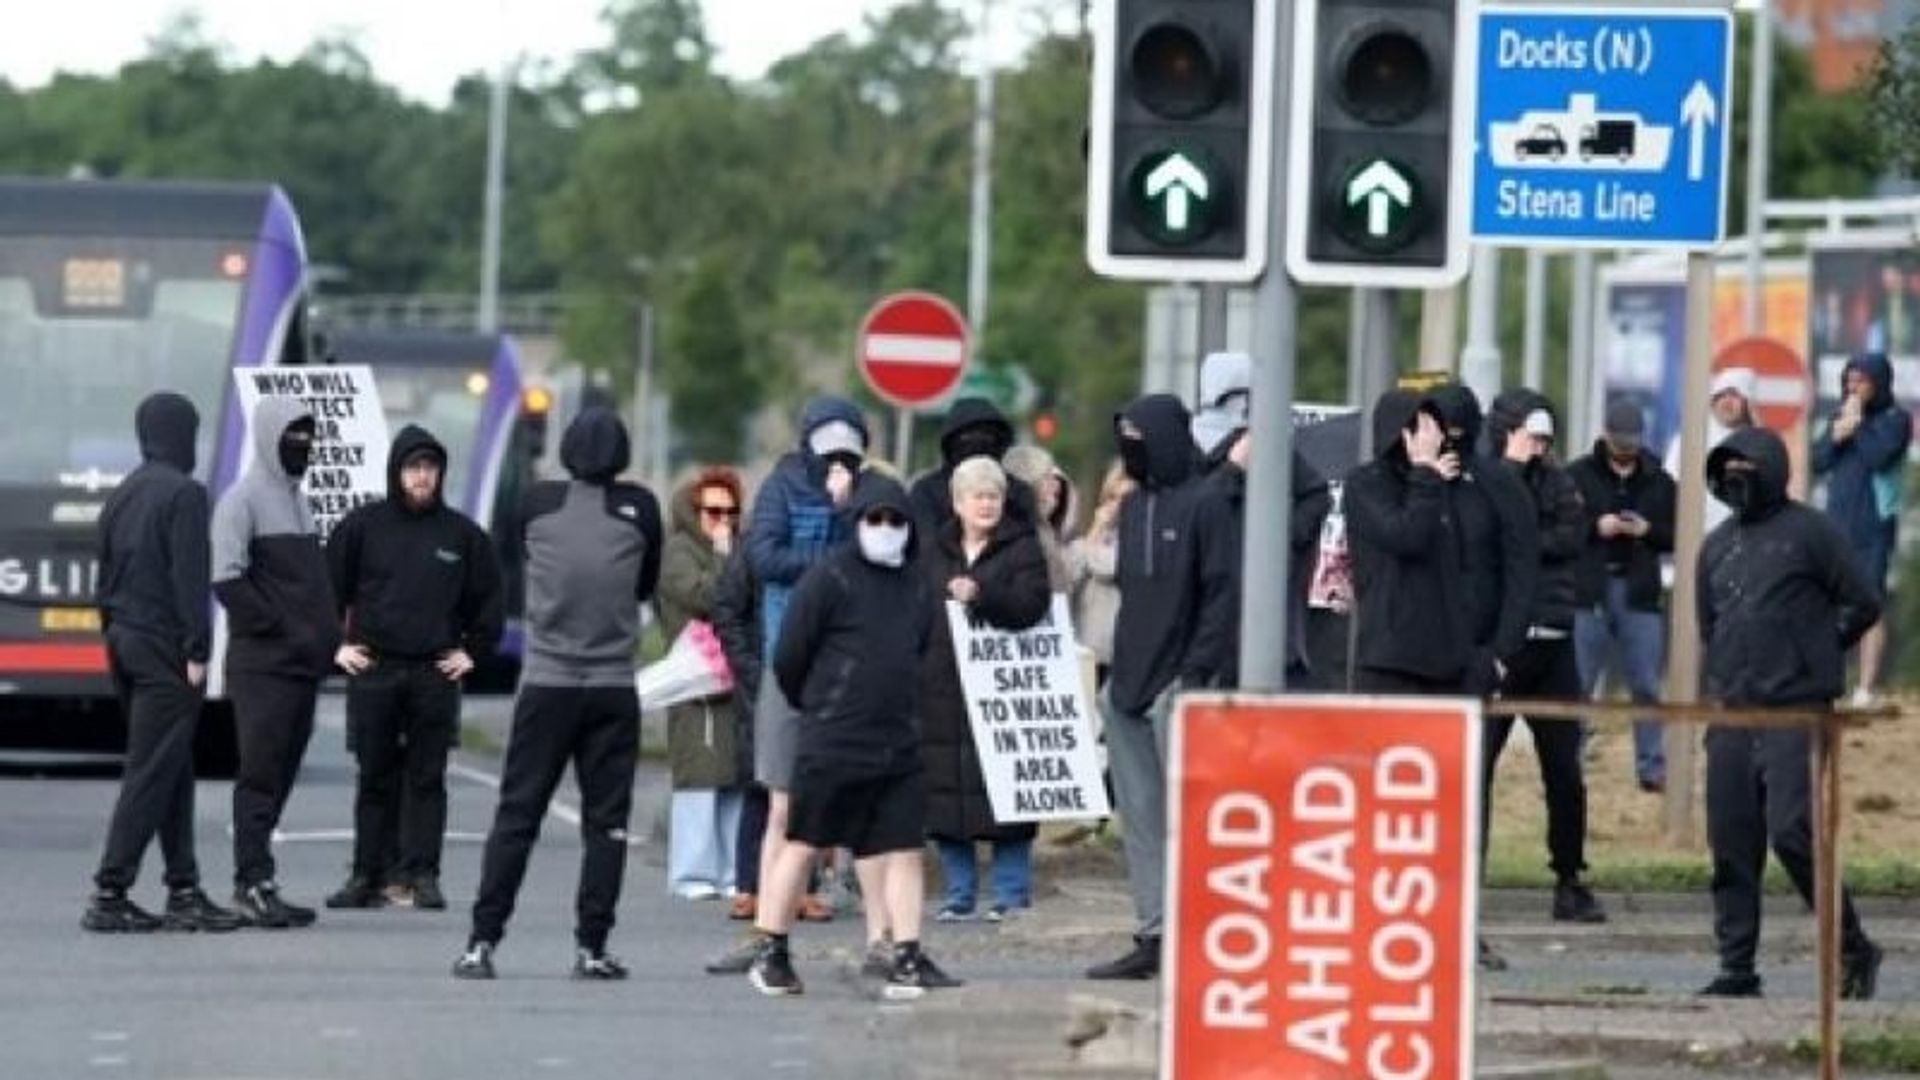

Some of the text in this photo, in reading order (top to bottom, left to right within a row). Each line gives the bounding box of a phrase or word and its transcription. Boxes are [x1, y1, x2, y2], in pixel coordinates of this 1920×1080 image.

[1497, 25, 1652, 75] Docks (N)
[1496, 179, 1656, 221] Stena Line
[253, 372, 360, 395] WHO WILL
[301, 397, 355, 417] TECT
[310, 468, 352, 489] AND
[968, 633, 1063, 661] ARE NOT
[993, 666, 1050, 691] SAFE
[978, 694, 1079, 723] TO WALK
[993, 726, 1077, 753] IN THIS
[1014, 756, 1074, 782] AREA
[1015, 787, 1087, 813] ALONE
[1203, 791, 1274, 1029] ROAD
[1285, 766, 1357, 1064] AHEAD
[1367, 745, 1438, 1080] CLOSED
